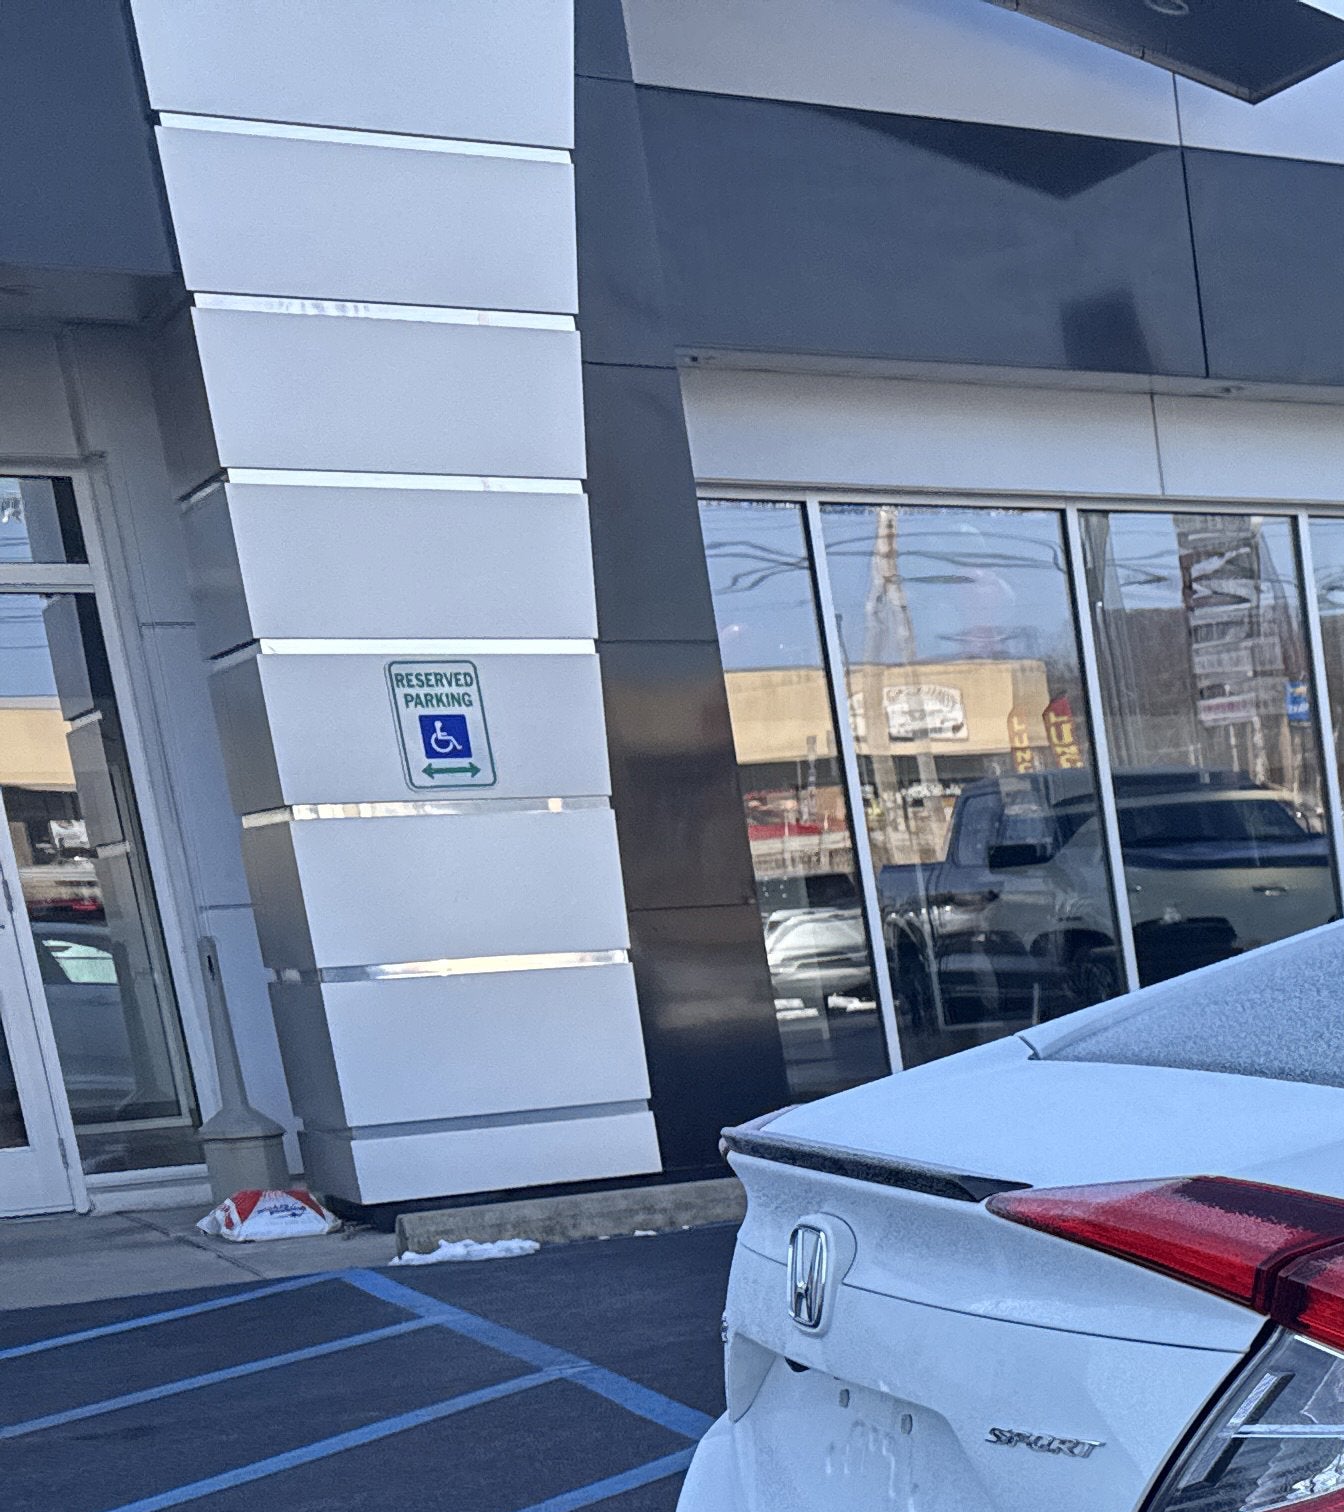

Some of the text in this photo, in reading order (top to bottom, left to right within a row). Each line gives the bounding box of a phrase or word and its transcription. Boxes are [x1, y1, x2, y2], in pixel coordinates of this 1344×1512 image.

[394, 671, 474, 689] RESERVED
[403, 692, 474, 709] PARKING
[984, 1426, 1108, 1460] SPORT
